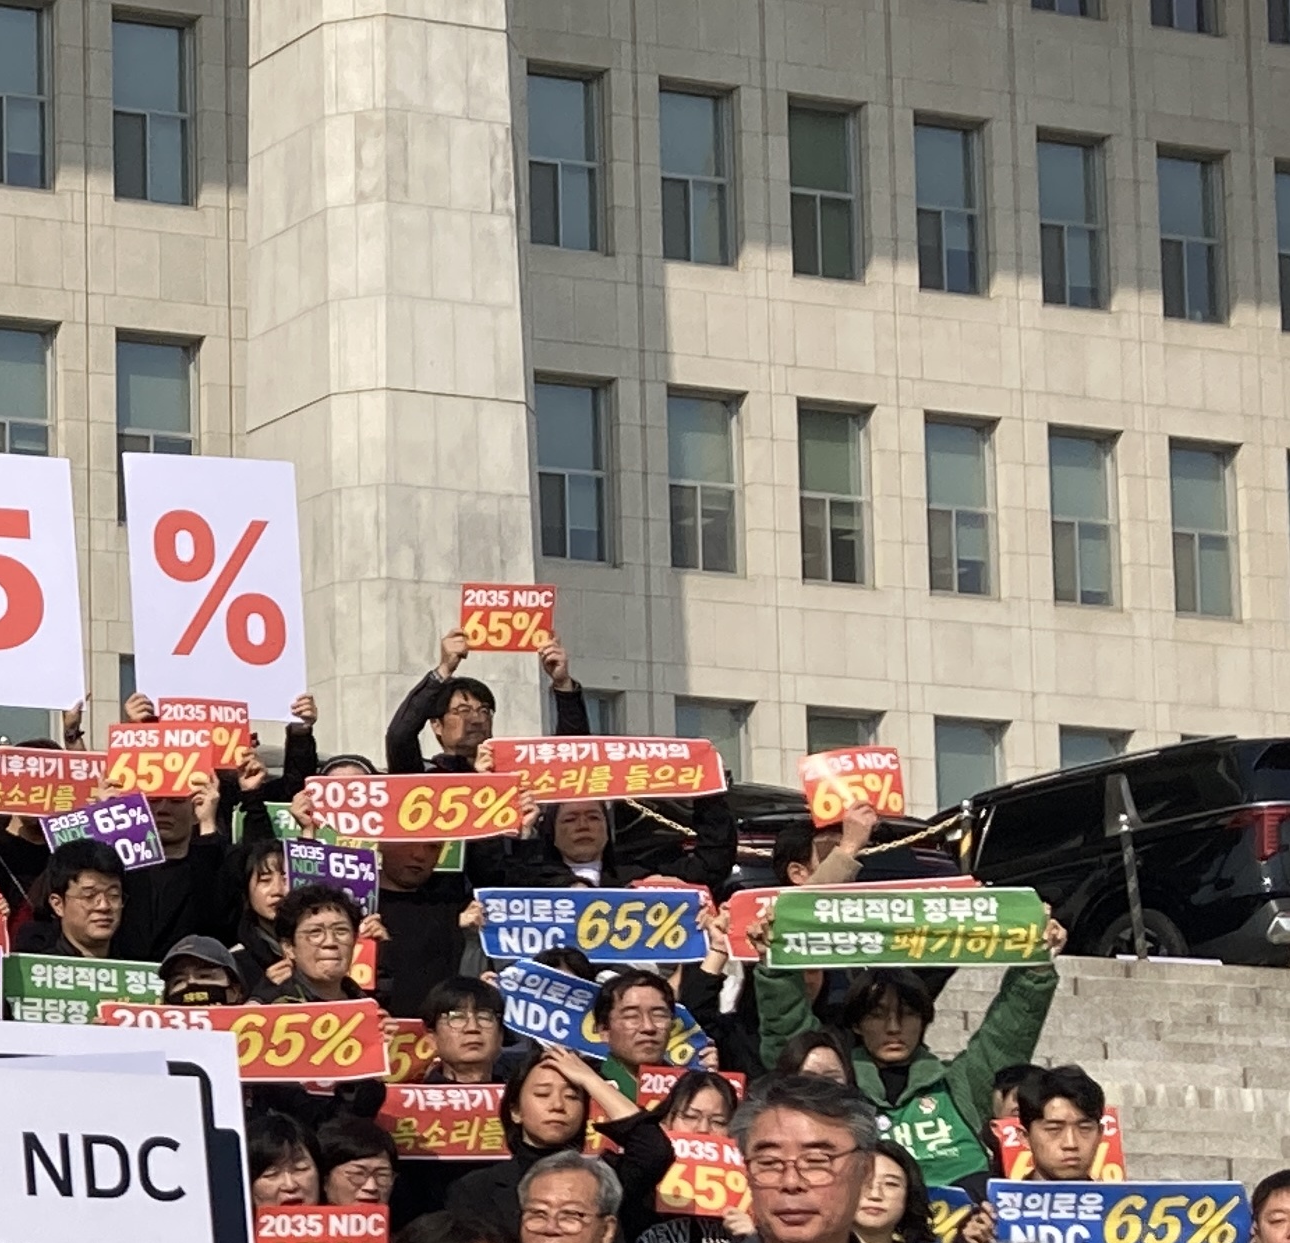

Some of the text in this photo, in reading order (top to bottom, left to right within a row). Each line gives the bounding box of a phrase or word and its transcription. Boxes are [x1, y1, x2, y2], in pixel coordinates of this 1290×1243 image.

[464, 589, 553, 608] 2035 NDC
[464, 611, 549, 649] 65%
[111, 728, 210, 749] 2035 NDC
[515, 742, 689, 764] 기후위기 당사자의
[857, 752, 898, 770] NDC
[625, 765, 704, 792] 들으라
[94, 803, 149, 833] 65%
[398, 785, 518, 831] 65%
[485, 899, 576, 924] 정의로운
[814, 896, 998, 923] 위헌적인 정부안
[577, 899, 690, 950] 65%
[783, 923, 1040, 960] 지금당장 폐기하라
[30, 964, 119, 993] 위헌적인
[499, 966, 594, 1012] 정의로운
[504, 1000, 570, 1039] NDC
[401, 1088, 494, 1112] 기후위기
[22, 1131, 187, 1202] NDC
[996, 1191, 1104, 1222] 정의로운
[258, 1213, 385, 1237] 2035 NDC
